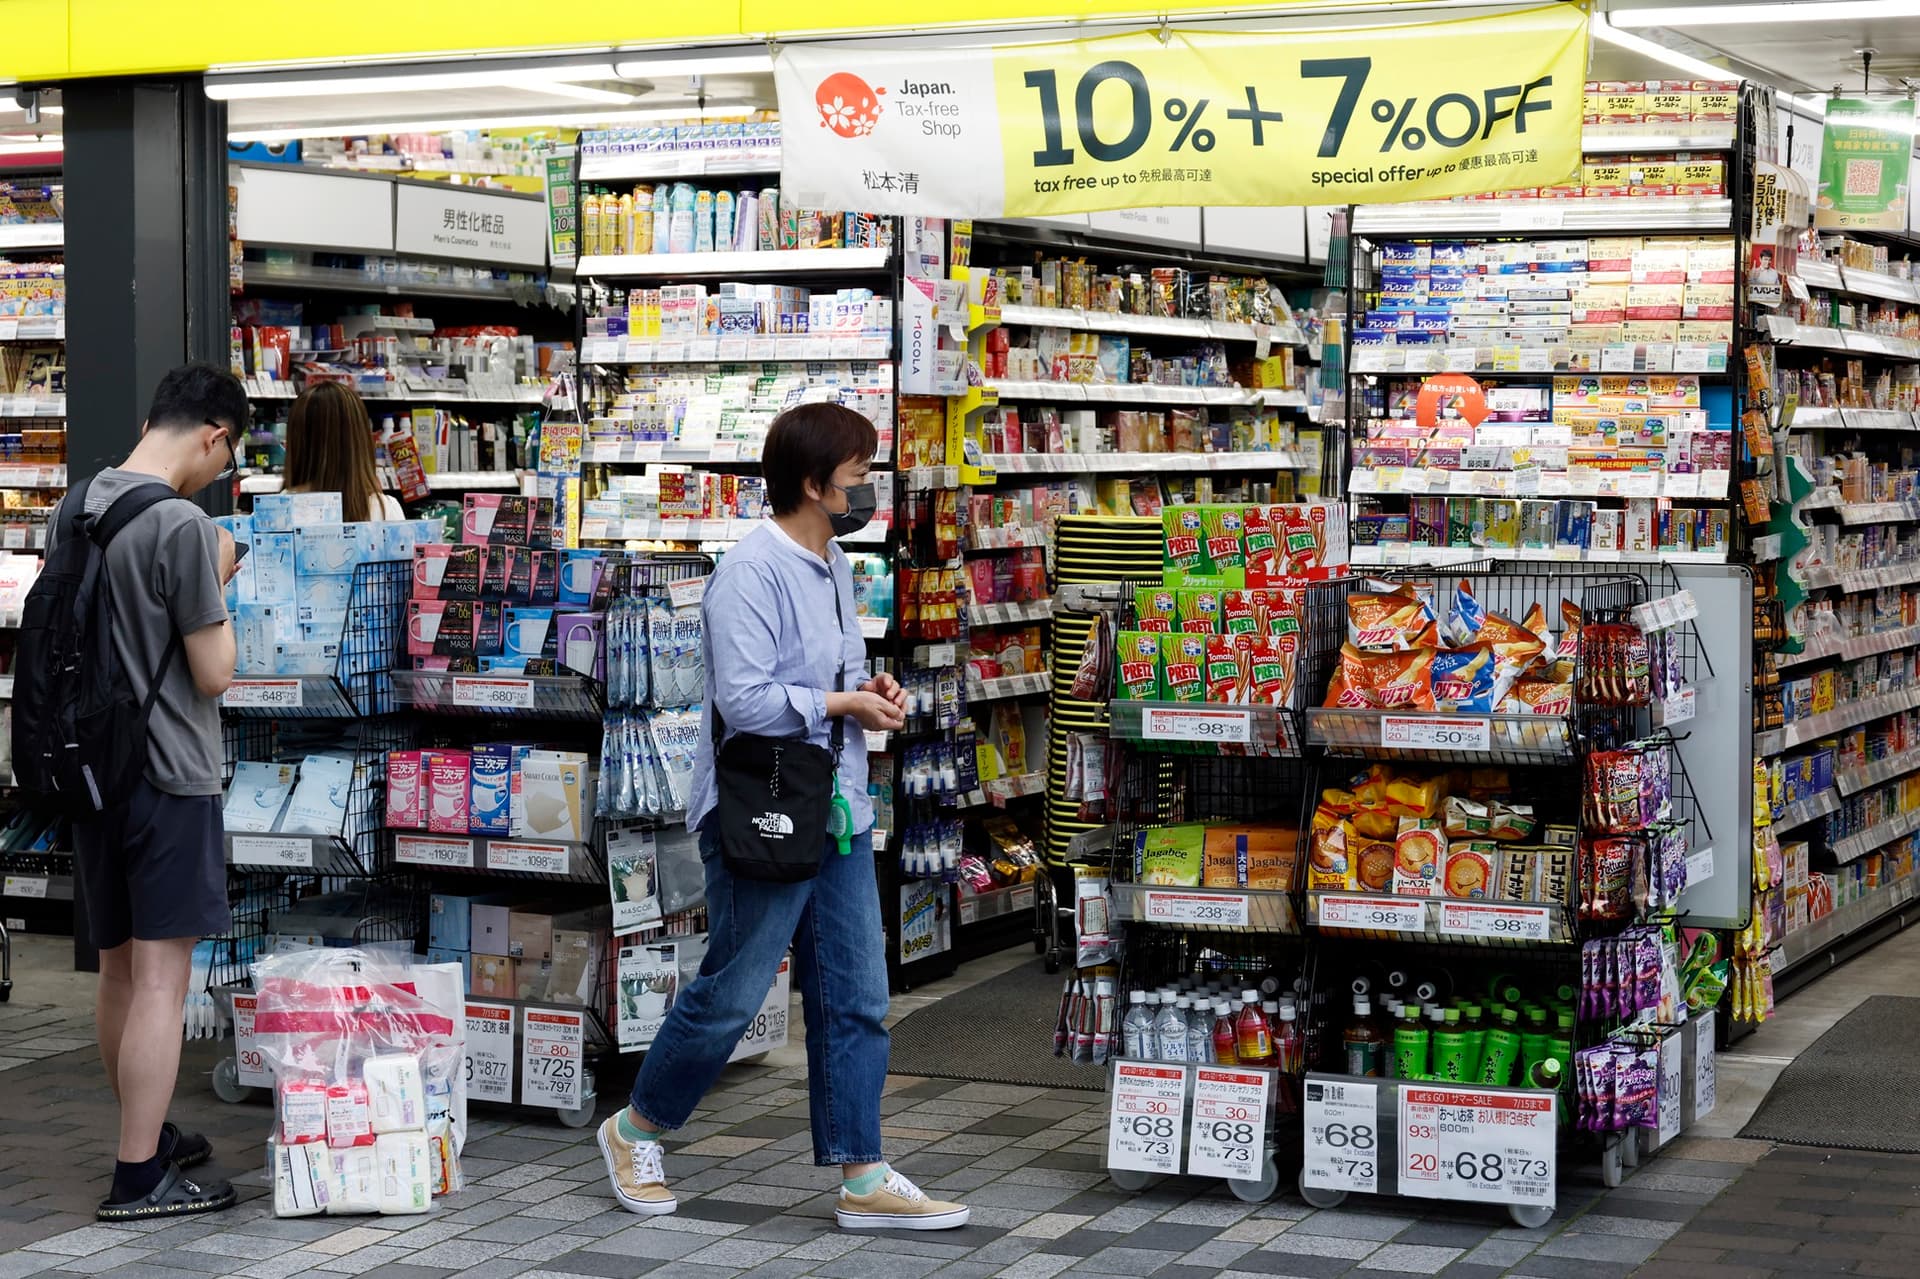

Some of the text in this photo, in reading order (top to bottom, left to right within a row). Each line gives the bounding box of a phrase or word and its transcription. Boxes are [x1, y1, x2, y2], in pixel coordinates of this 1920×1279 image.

[899, 79, 956, 97] Japan.
[896, 101, 959, 118] Tax-free
[922, 120, 961, 139] Shop
[863, 170, 920, 195] 松本清
[1034, 179, 1060, 193] tax
[1063, 174, 1097, 190] free
[1101, 176, 1120, 188] up
[1123, 172, 1137, 184] to
[1311, 167, 1374, 188] special
[1379, 166, 1425, 182] offer
[1426, 165, 1442, 178] up
[1444, 163, 1456, 174] to
[443, 208, 504, 235] 男性化粧品
[433, 235, 450, 244] Men's
[451, 236, 479, 247] Cosmetics
[912, 315, 922, 375] MOCOLA
[1246, 526, 1270, 534] Tomato
[1286, 526, 1311, 534] Tomato
[504, 535, 524, 543] MASK
[1247, 534, 1275, 552] PRETZ
[1289, 535, 1315, 552] PRETZ
[1634, 533, 1645, 551] PL
[1167, 538, 1198, 556] PRETZ
[1208, 539, 1239, 556] PRETZ
[456, 584, 476, 592] MASK
[1183, 577, 1207, 586] プリッツ
[1226, 608, 1252, 616] Tomato
[1269, 609, 1294, 617] Tomato
[1139, 619, 1170, 632] PRETZ
[1182, 619, 1213, 633] PRETZ
[1228, 619, 1256, 634] PRETZ
[1271, 620, 1298, 634] PRETZ
[1357, 628, 1397, 645] クリスプ
[450, 640, 470, 648] MASK
[1209, 652, 1235, 661] Tomato
[1252, 655, 1279, 663] Tomato
[1123, 664, 1154, 681] PRETZ
[1168, 665, 1200, 683] PRETZ
[1210, 663, 1238, 680] PRETZ
[1254, 666, 1283, 682] PRETZ
[262, 690, 282, 701] 648
[493, 690, 513, 701] 680
[1379, 684, 1414, 704] クリスプ
[1433, 681, 1473, 699] クリスプ
[1198, 723, 1224, 735] 98
[1435, 731, 1461, 743] 50
[1467, 733, 1480, 742] 54
[390, 763, 418, 774] 三次元
[474, 758, 508, 769] 三次元
[431, 768, 466, 780] 三次元
[541, 771, 560, 782] COLOR
[752, 817, 779, 827] NORTH
[765, 812, 780, 820] THE
[280, 850, 293, 860] 498
[528, 855, 548, 867] 1098
[1144, 848, 1188, 860] Jagabee
[1238, 854, 1248, 884] 大容量
[1250, 856, 1295, 869] Jagabee
[1397, 879, 1431, 888] ハーベスト
[1197, 907, 1222, 919] 238
[1372, 911, 1398, 924] 98
[1448, 919, 1461, 927] 10
[1494, 919, 1521, 932] 98
[622, 970, 653, 982] Active
[772, 1011, 786, 1026] 105
[551, 1045, 569, 1056] 80
[241, 1050, 261, 1066] 30
[485, 1061, 507, 1076] 877
[541, 1057, 575, 1079] 725
[549, 1080, 572, 1093] 797
[1146, 1101, 1167, 1114] 30
[1414, 1091, 1432, 1101] Let's
[1513, 1100, 1545, 1110] 7/15まで
[1225, 1106, 1247, 1120] 30
[1133, 1115, 1174, 1138] 68
[1212, 1121, 1254, 1144] 68
[1409, 1125, 1430, 1138] 93
[1325, 1123, 1375, 1149] 68
[1143, 1140, 1169, 1155] 73
[1222, 1146, 1249, 1161] 73
[1345, 1160, 1374, 1178] 73
[1410, 1153, 1436, 1171] 20
[1441, 1161, 1454, 1169] 本体
[1455, 1152, 1503, 1181] 68
[1518, 1159, 1548, 1177] 73
